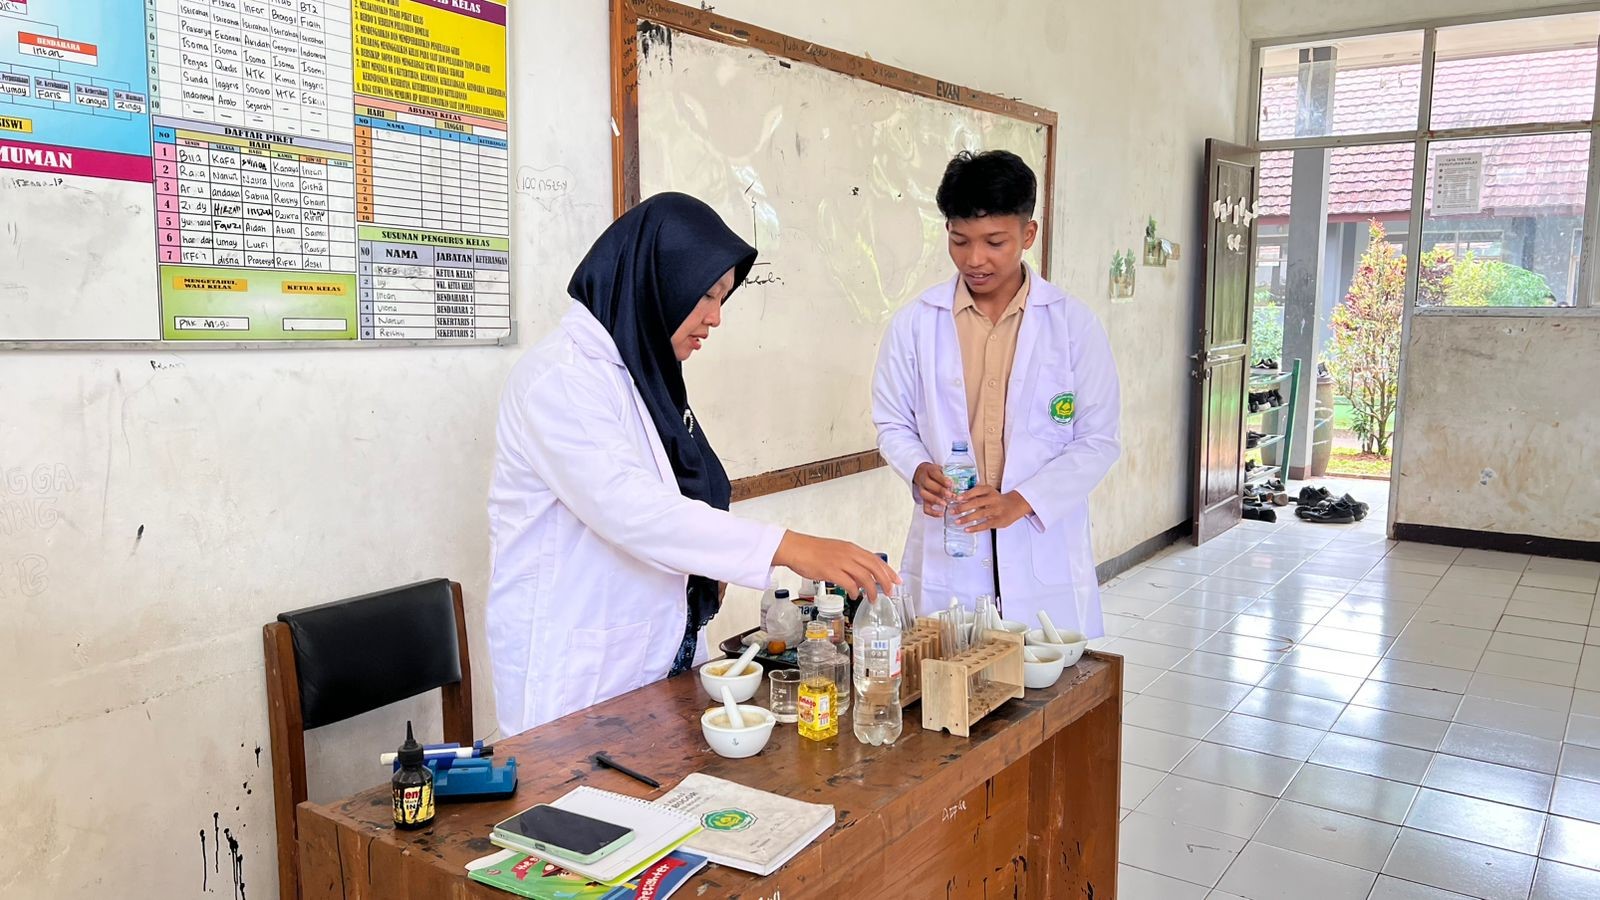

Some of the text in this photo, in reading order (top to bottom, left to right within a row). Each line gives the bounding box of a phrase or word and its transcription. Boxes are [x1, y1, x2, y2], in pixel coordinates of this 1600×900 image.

[936, 80, 960, 100] EVAN
[367, 108, 385, 117] HARI
[158, 131, 170, 139] NO
[224, 127, 294, 145] DAFTAR PIKET
[249, 141, 271, 149] HARI
[162, 147, 167, 156] 1
[162, 165, 169, 174] 2
[163, 182, 170, 191] 3
[164, 200, 170, 208] 4
[165, 217, 172, 226] 5
[166, 233, 172, 242] 6
[382, 230, 490, 247] SUSUNAN PENGURUS KELAS
[166, 251, 172, 260] 7
[385, 249, 418, 259] NAMA
[436, 252, 472, 263] JABATAN
[437, 294, 469, 303] BENDAHARA
[437, 306, 469, 314] BENDAHARA
